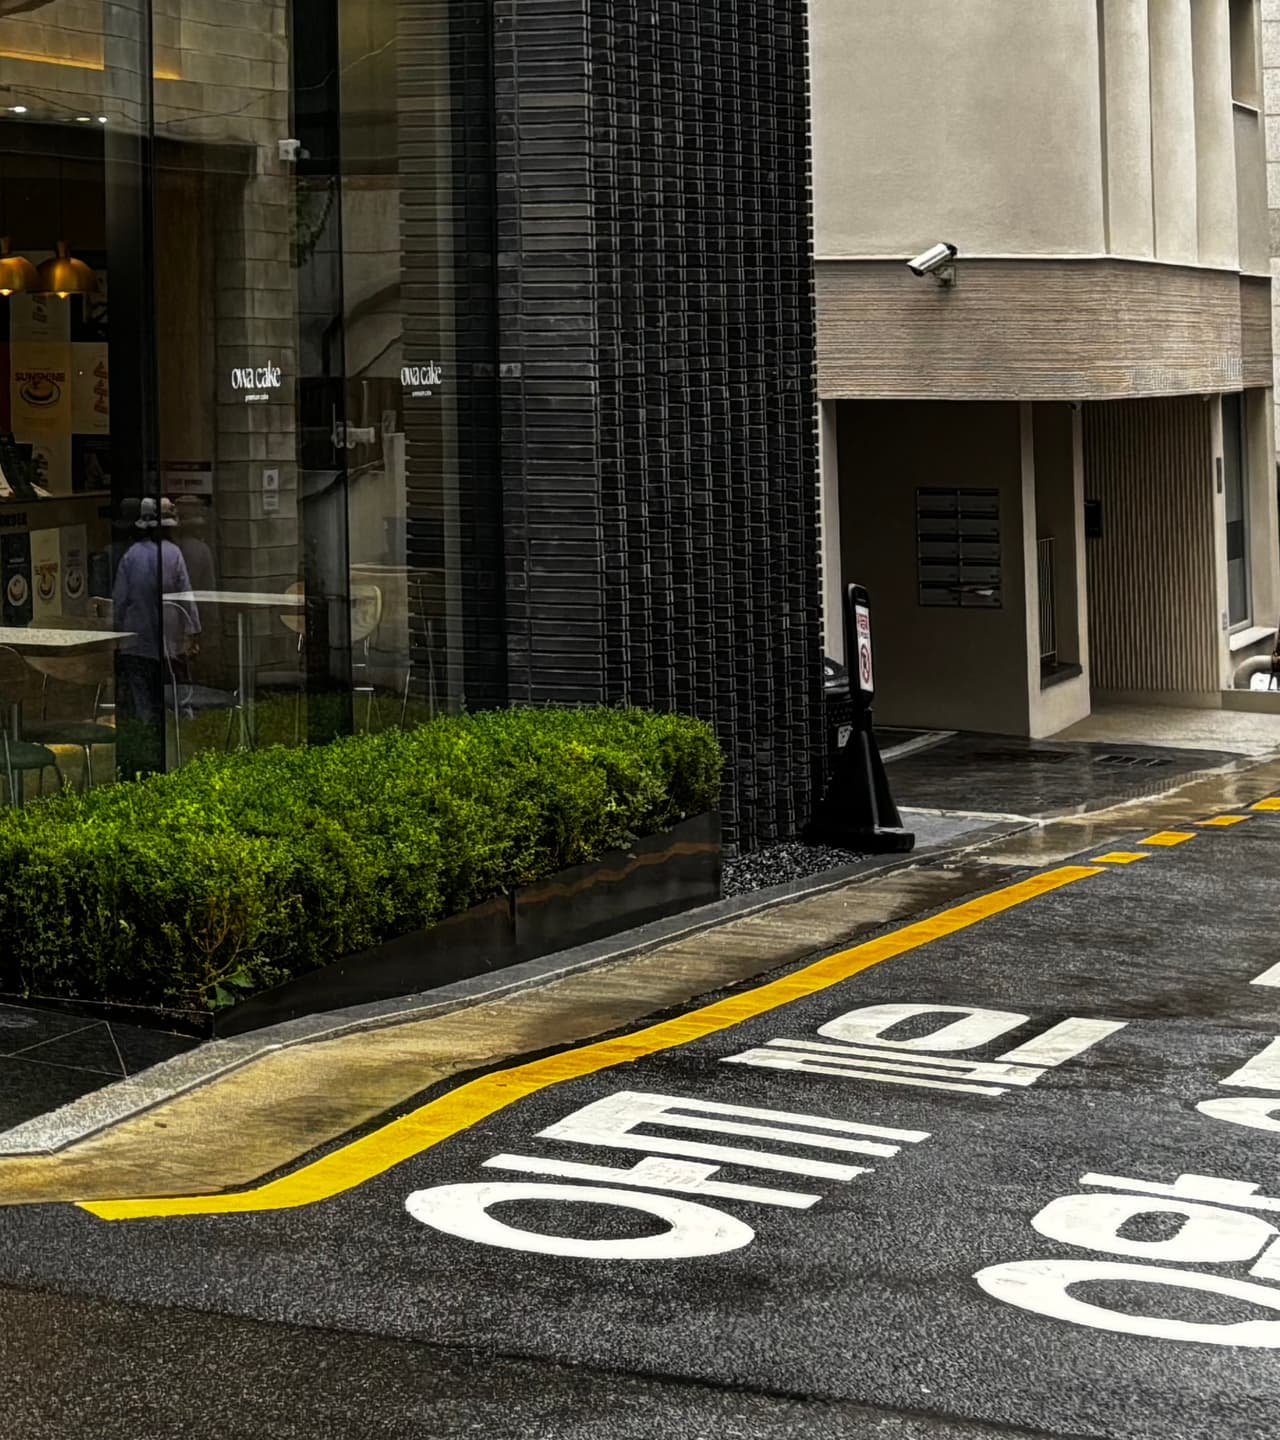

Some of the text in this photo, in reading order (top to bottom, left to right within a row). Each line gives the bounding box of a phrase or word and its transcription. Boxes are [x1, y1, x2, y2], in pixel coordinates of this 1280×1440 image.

[231, 360, 282, 389] owa cake
[421, 360, 442, 386] cake
